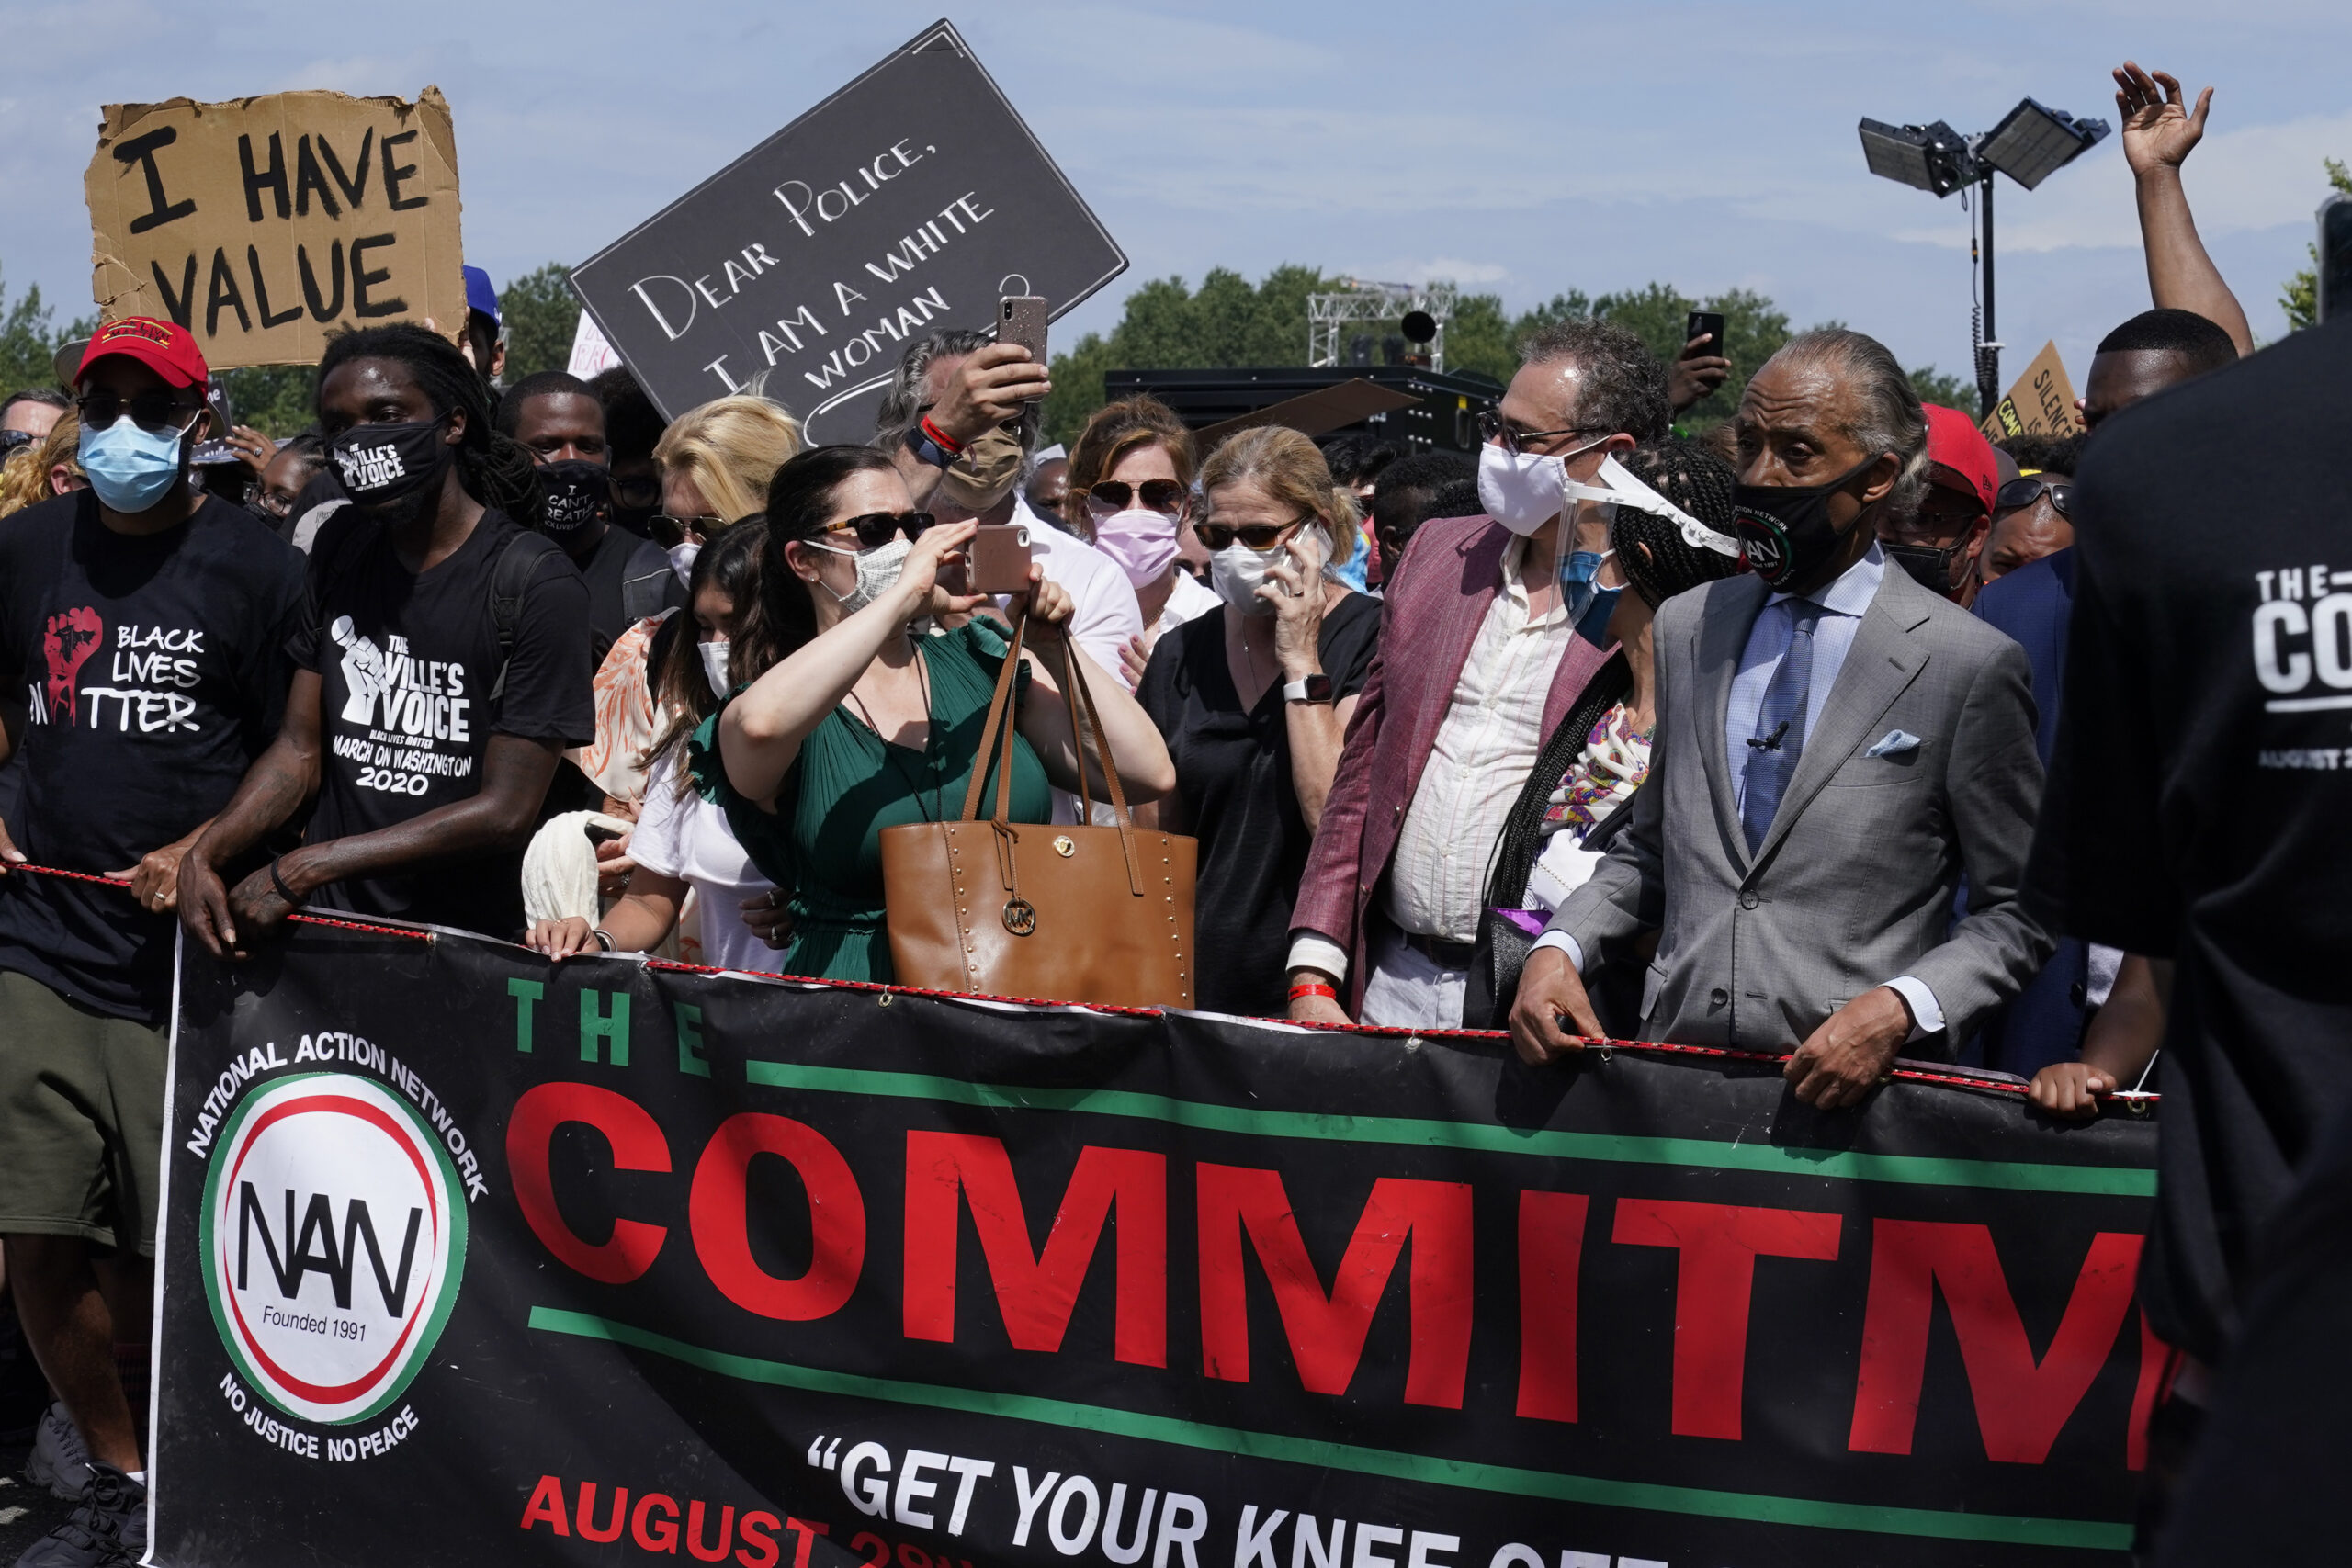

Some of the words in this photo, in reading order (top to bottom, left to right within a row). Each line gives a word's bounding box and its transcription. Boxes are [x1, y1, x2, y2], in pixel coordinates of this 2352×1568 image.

[112, 125, 198, 234] I
[238, 126, 429, 222] HAVE
[628, 243, 780, 342] DEAR
[773, 138, 937, 237] POLICE,
[151, 233, 409, 338] VALUE
[703, 354, 751, 395] I
[758, 305, 827, 366] AM
[833, 281, 867, 316] A
[865, 191, 995, 284] WHITE
[804, 286, 951, 389] WOMAN
[350, 444, 398, 467] VILLE'S
[358, 457, 405, 486] VOICE
[568, 485, 577, 496] I
[2255, 564, 2330, 604] THE
[112, 650, 202, 688] LIVES
[117, 625, 205, 654] BLACK
[384, 650, 465, 697] VILLE'S
[388, 634, 410, 655] THE
[2252, 592, 2352, 694] CO
[382, 689, 470, 743] VOICE
[333, 735, 374, 763] MARCH
[374, 745, 391, 767] ON
[393, 748, 472, 778] WASHINGTON
[356, 766, 429, 796] 2020
[507, 976, 712, 1079] THE
[186, 1042, 288, 1159] NATIONAL
[294, 1031, 386, 1074] ACTION
[390, 1056, 489, 1203] NETWORK
[237, 1180, 423, 1320] NAN
[263, 1305, 327, 1335] Founded
[333, 1318, 367, 1342] 1991
[219, 1372, 246, 1412] NO
[243, 1406, 320, 1459] JUSTICE
[327, 1438, 356, 1462] NO
[358, 1404, 419, 1460] PEACE
[520, 1475, 829, 1568] AUGUST
[1012, 1464, 1210, 1568] YOUR
